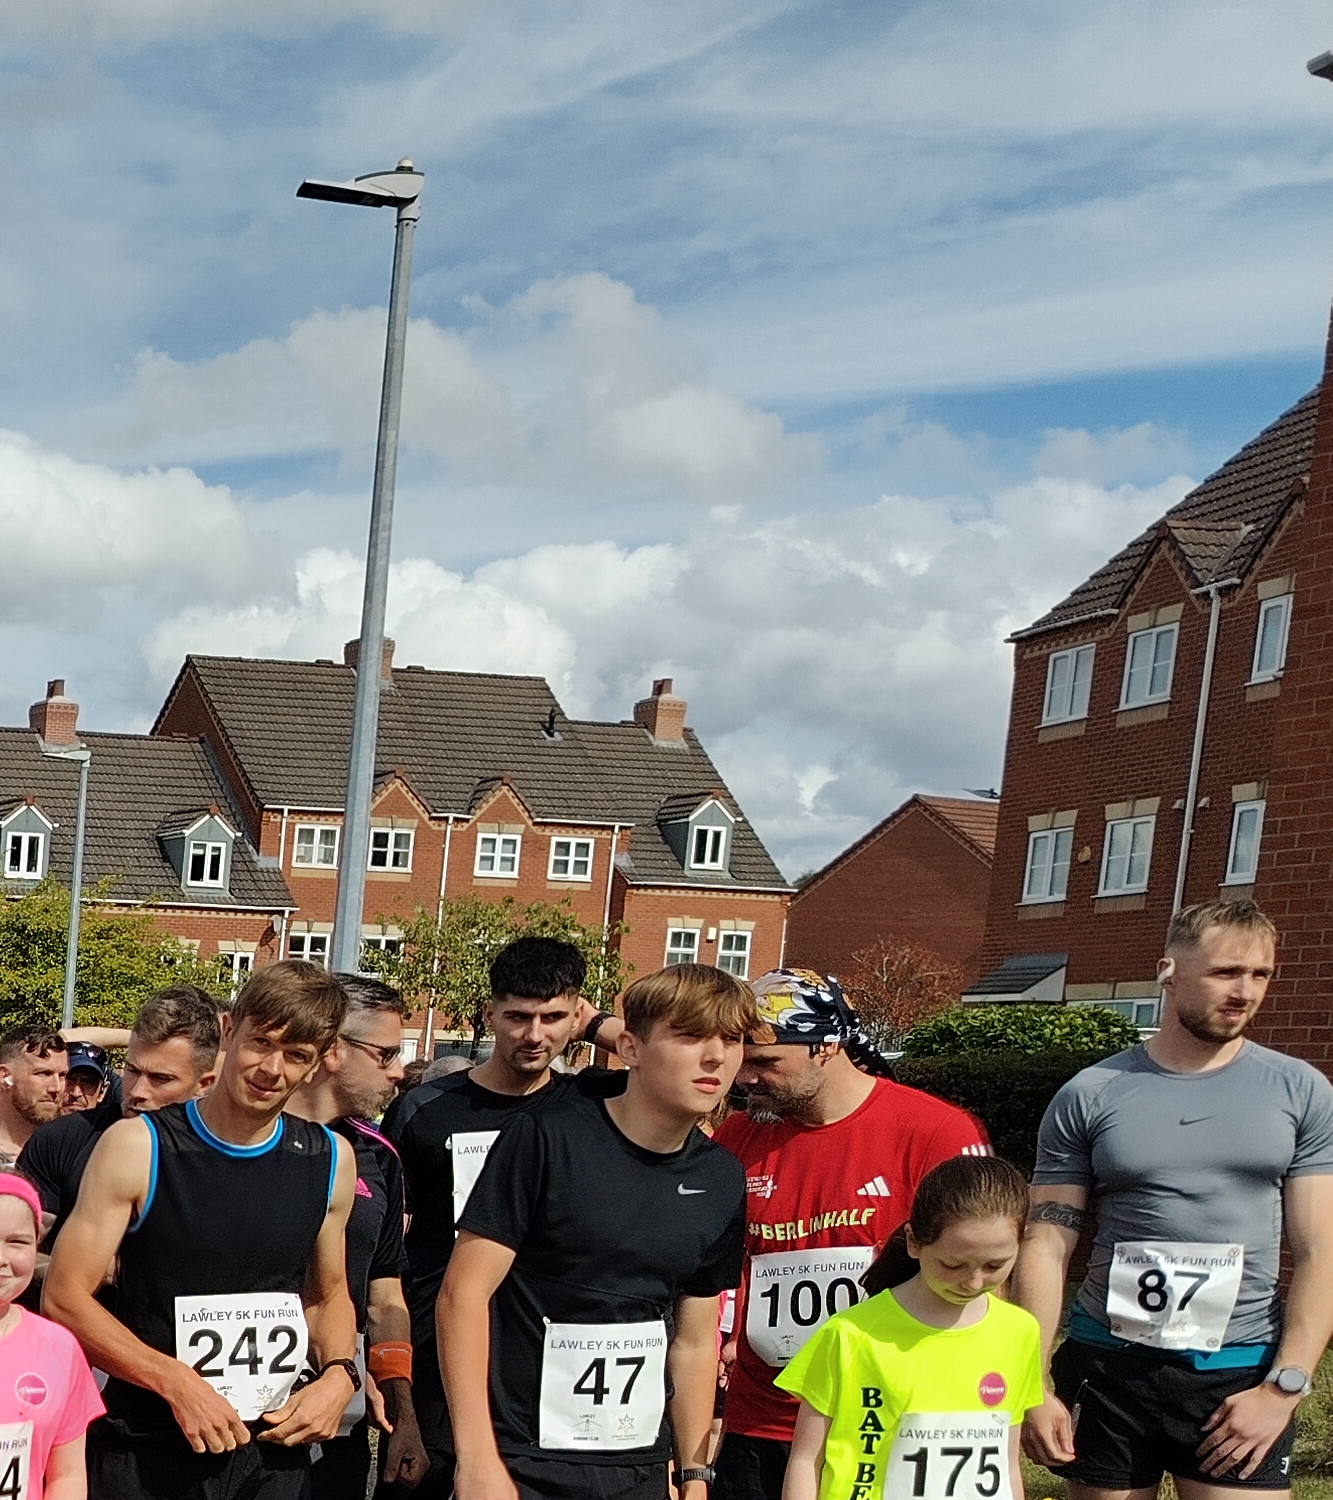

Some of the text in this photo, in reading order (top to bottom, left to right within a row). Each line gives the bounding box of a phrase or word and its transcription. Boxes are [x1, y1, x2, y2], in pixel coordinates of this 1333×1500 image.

[748, 1207, 876, 1241] #BERLINHALF
[755, 1261, 864, 1279] LAWLEY 5K FUN RUN
[1118, 1255, 1236, 1267] LAWLEY 5K FUN RUN
[760, 1277, 859, 1328] 100
[1137, 1269, 1211, 1313] 87
[183, 1309, 298, 1323] LAWLEY 5K FUN RUN
[189, 1325, 298, 1378] 242
[550, 1338, 663, 1350] LAWLEY 5K FUN RUN
[573, 1356, 646, 1405] 47
[858, 1387, 885, 1455] BAT
[899, 1429, 947, 1440] LAWLEY
[950, 1429, 963, 1439] 5K
[967, 1429, 987, 1439] FUN
[12, 1437, 28, 1449] RUN
[902, 1446, 1000, 1498] 175
